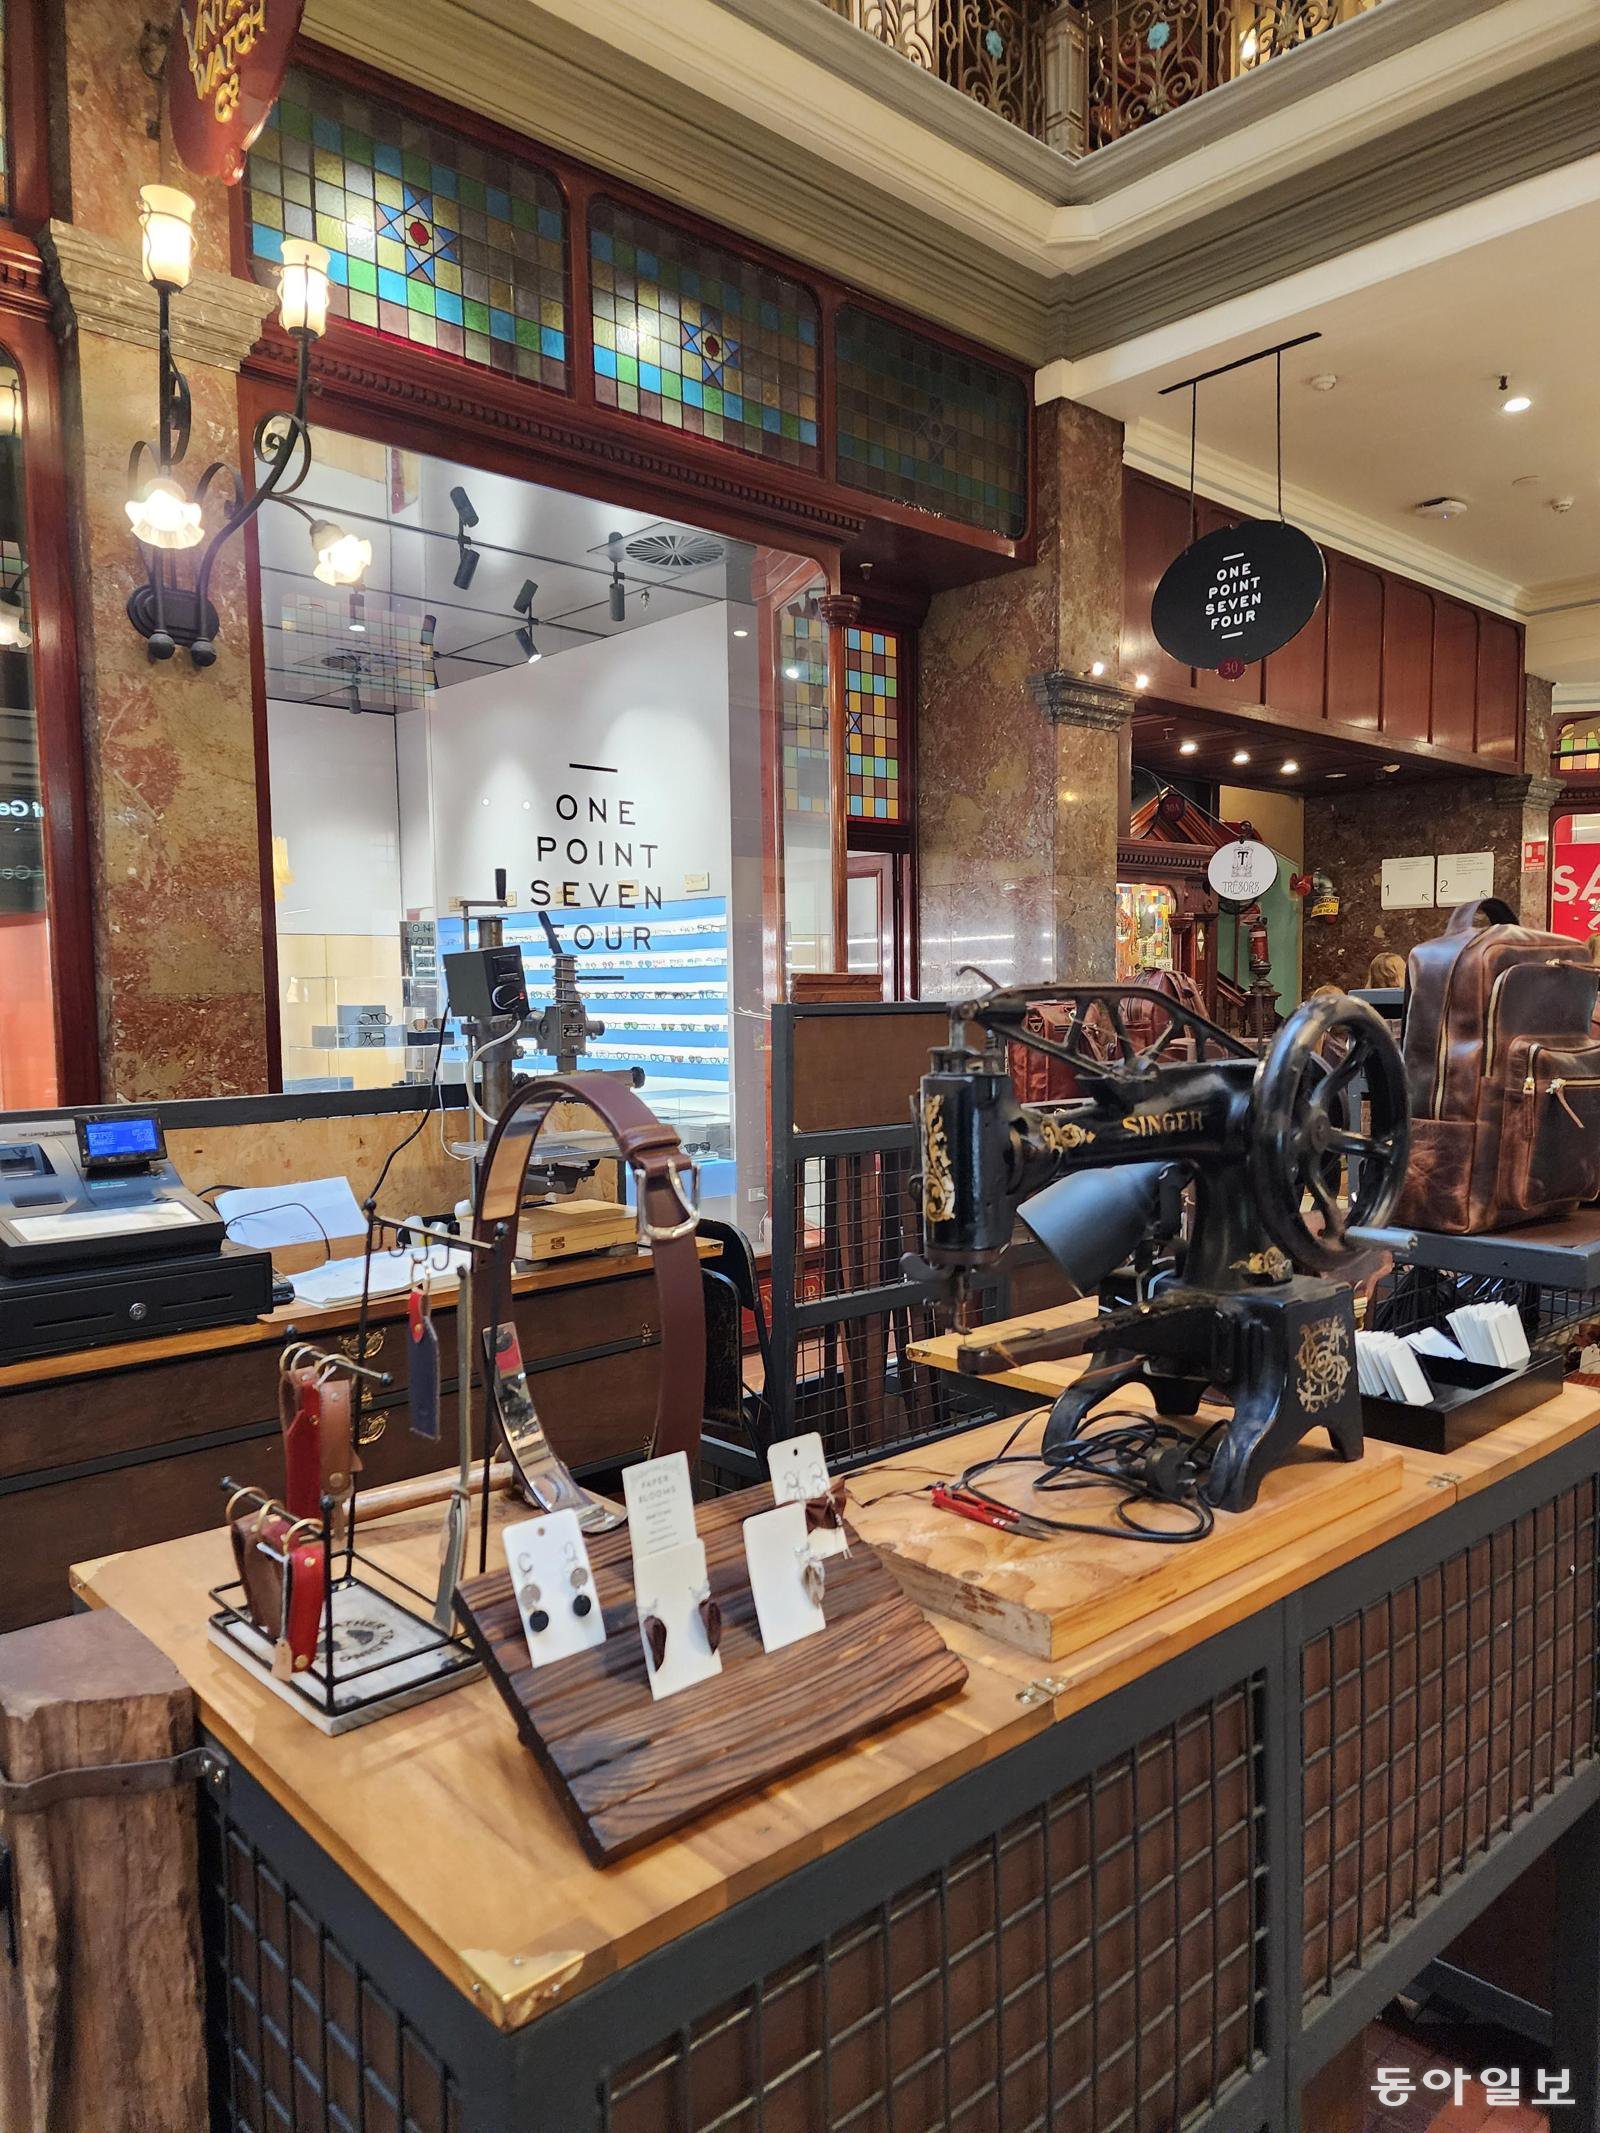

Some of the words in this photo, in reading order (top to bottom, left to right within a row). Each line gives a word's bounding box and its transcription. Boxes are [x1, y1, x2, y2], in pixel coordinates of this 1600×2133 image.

[188, 0, 266, 100] WATCH
[1216, 562, 1251, 581] ONE
[1208, 576, 1261, 599] POINT
[1205, 592, 1262, 616] SEVEN
[1210, 609, 1256, 631] FOUR
[1224, 662, 1239, 675] 30
[555, 793, 637, 826] ONE
[537, 836, 660, 870] POINT
[530, 879, 663, 910] SEVEN
[1385, 884, 1390, 897] 1
[1440, 879, 1449, 893] 2
[1122, 1109, 1205, 1137] SINGER
